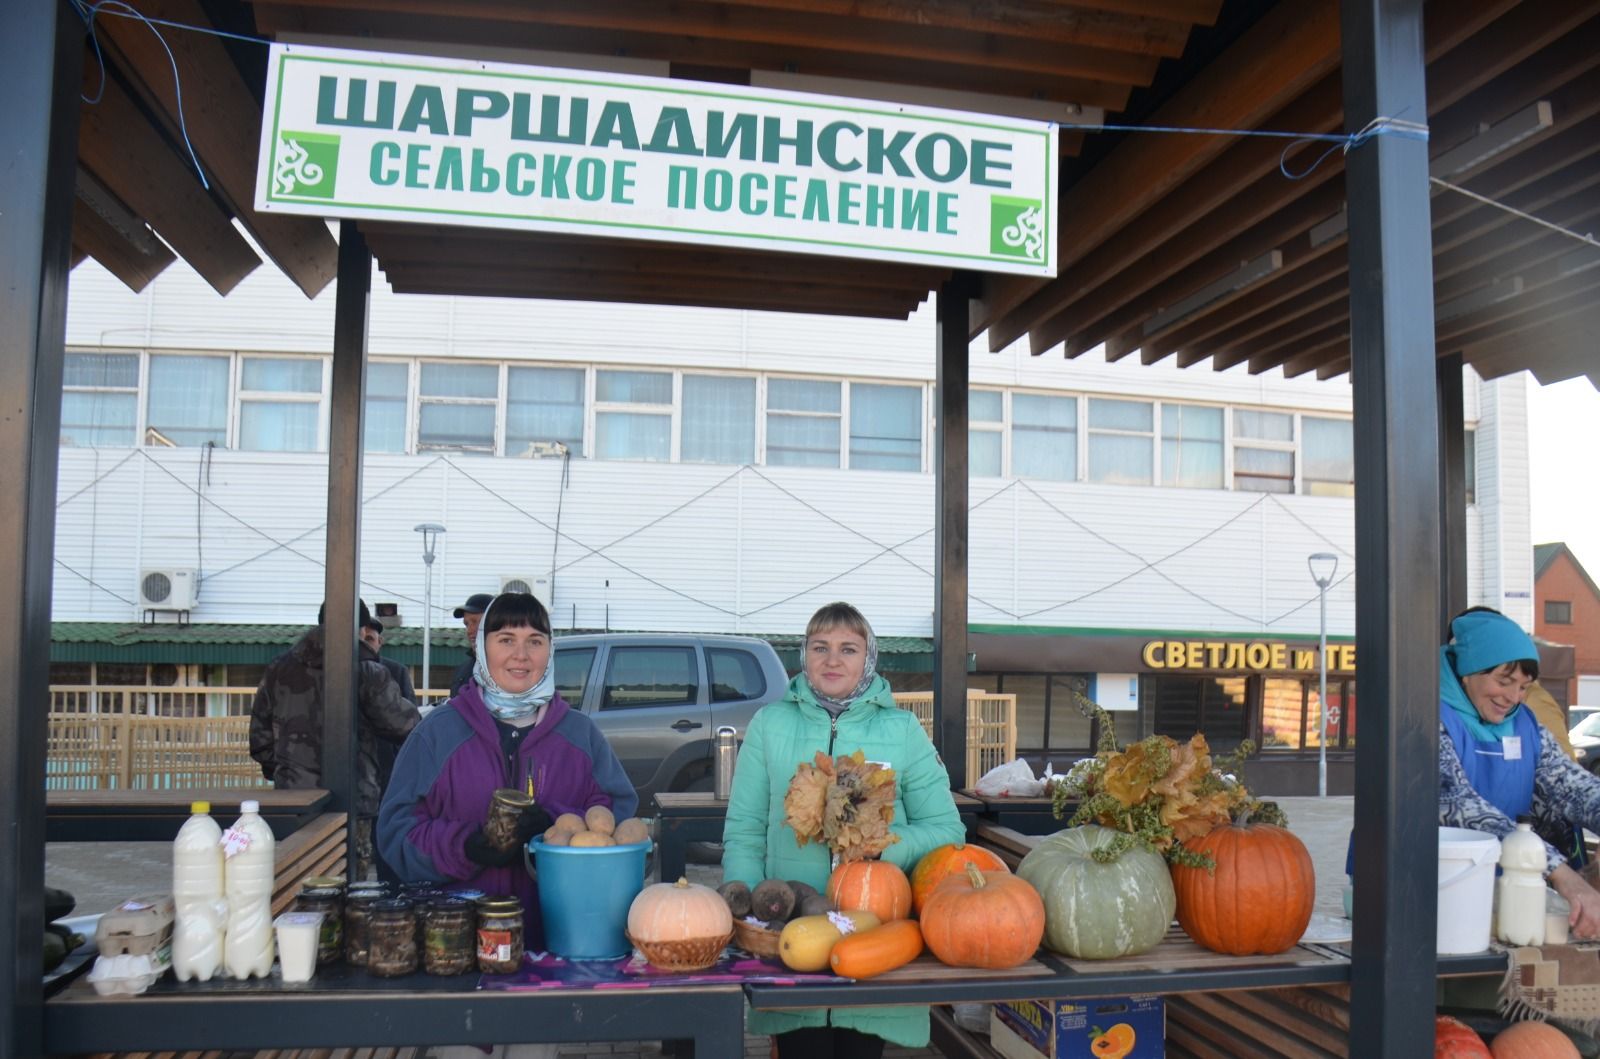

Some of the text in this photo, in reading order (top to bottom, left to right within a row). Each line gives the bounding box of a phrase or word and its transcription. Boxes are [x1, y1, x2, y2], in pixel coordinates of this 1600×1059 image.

[317, 76, 1012, 189] ШАРШАДИНСКОЕ
[369, 141, 960, 236] СЕЛЬСКОЕ ПОСЕЛЕНИЕ
[1143, 640, 1287, 670] СВЕТЛОЕ
[1296, 650, 1314, 670] и
